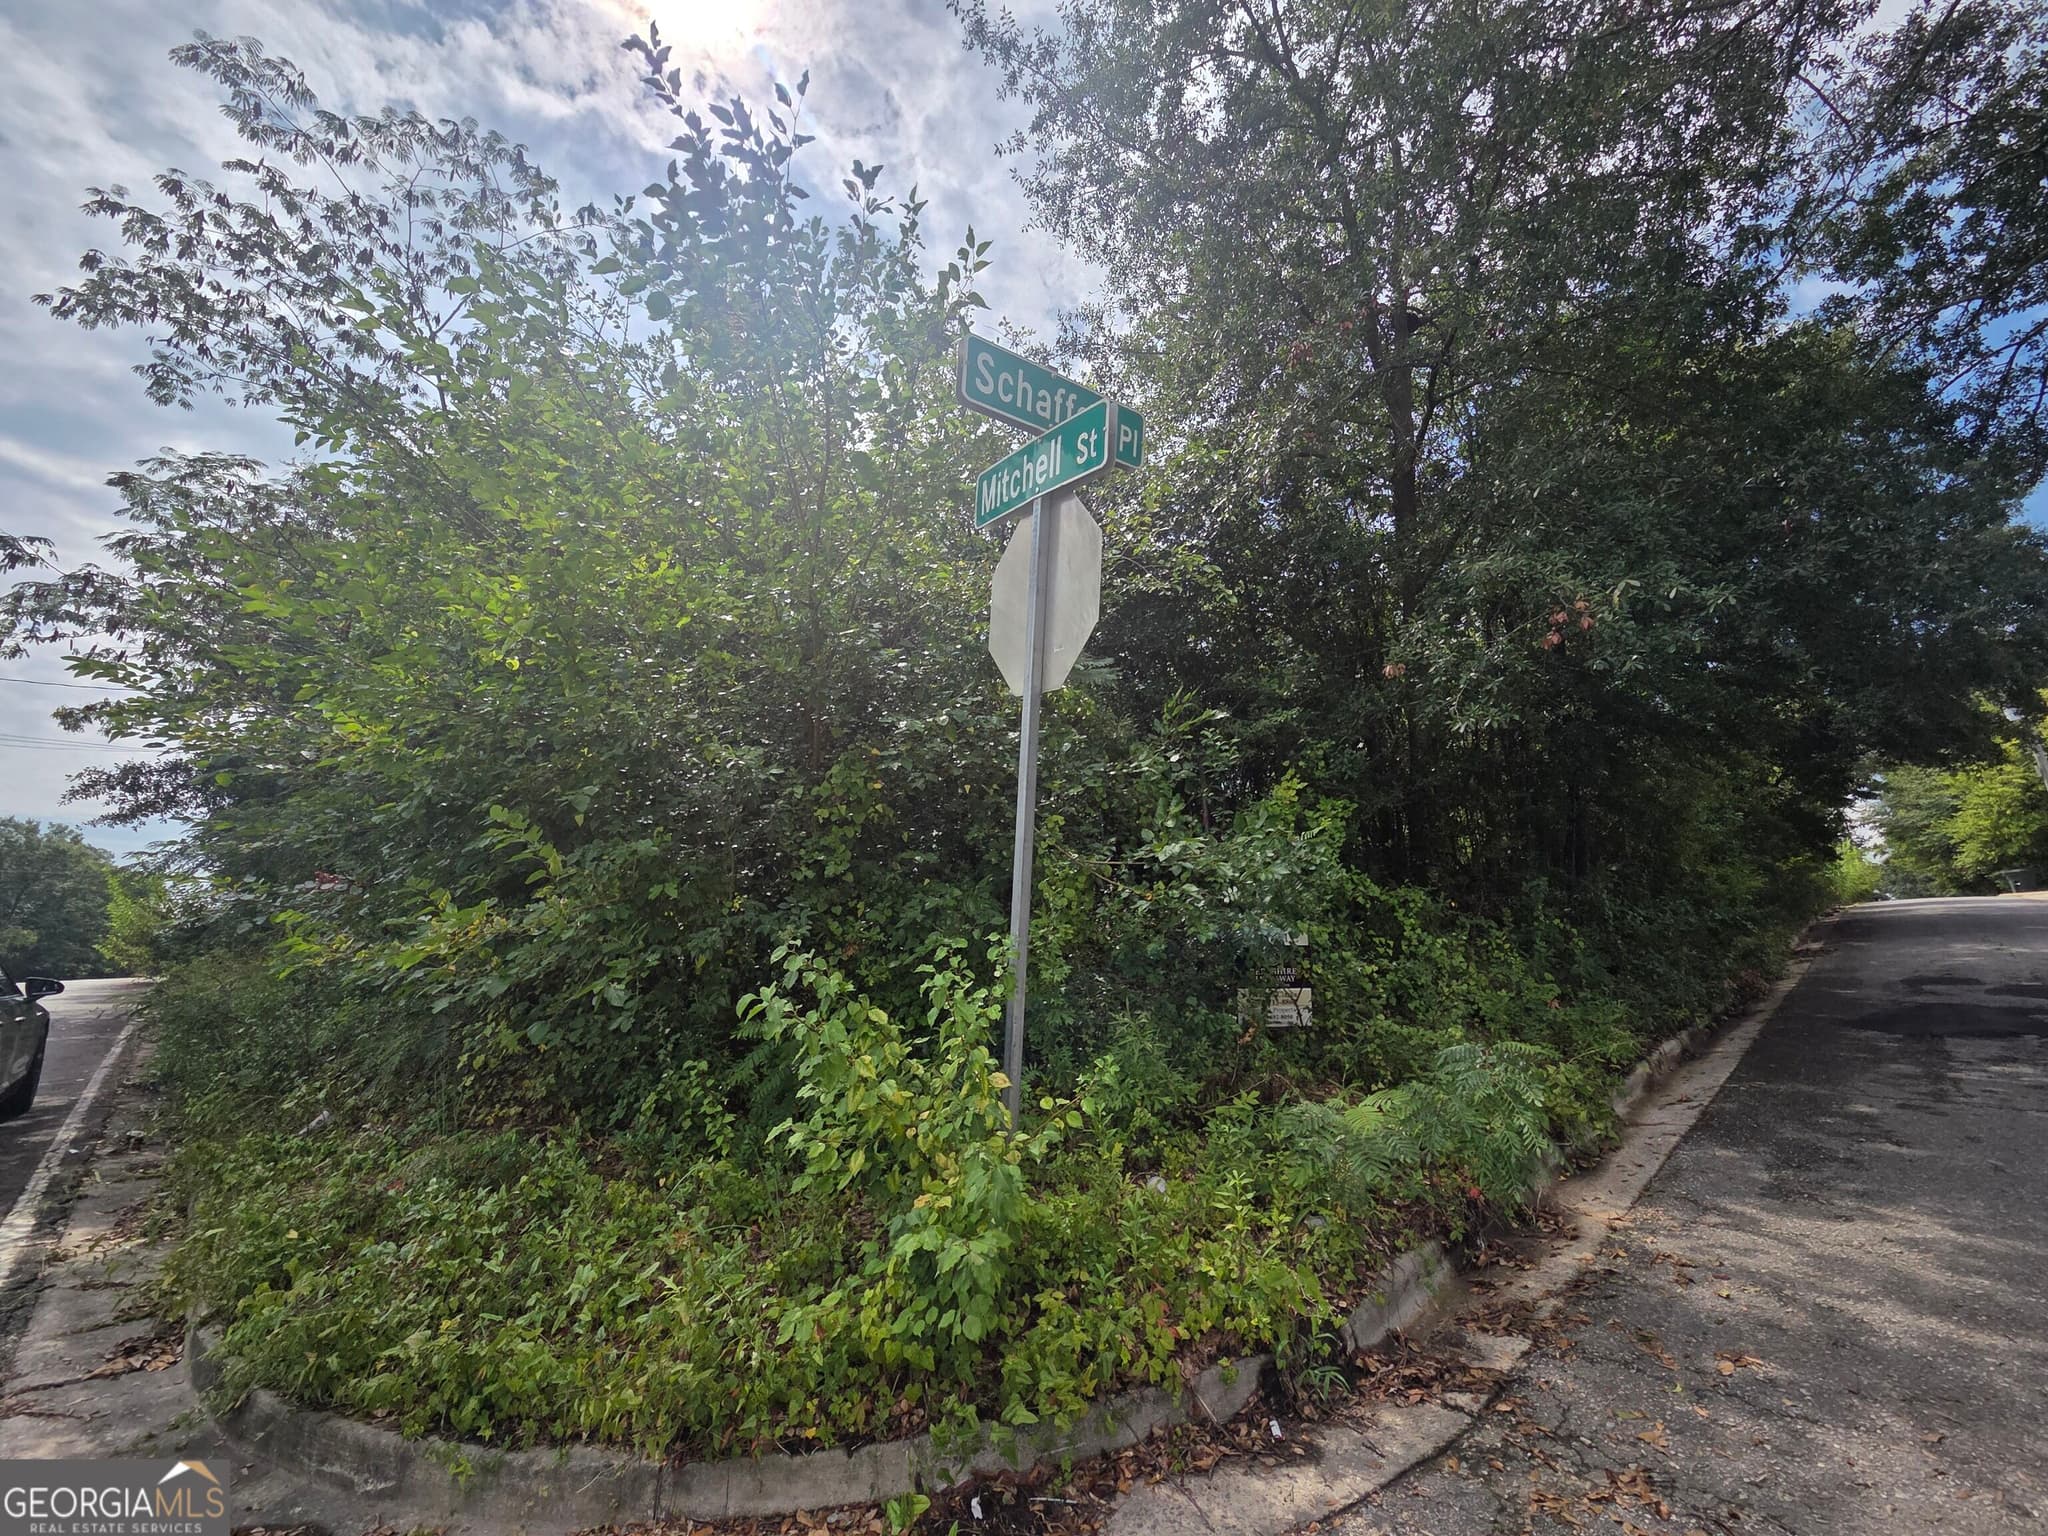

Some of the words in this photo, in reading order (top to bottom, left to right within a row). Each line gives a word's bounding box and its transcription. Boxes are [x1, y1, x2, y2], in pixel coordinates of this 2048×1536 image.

[975, 351, 1087, 424] Schaff
[1118, 424, 1138, 458] Pl
[980, 434, 1063, 517] Mitchell
[1076, 428, 1098, 465] St
